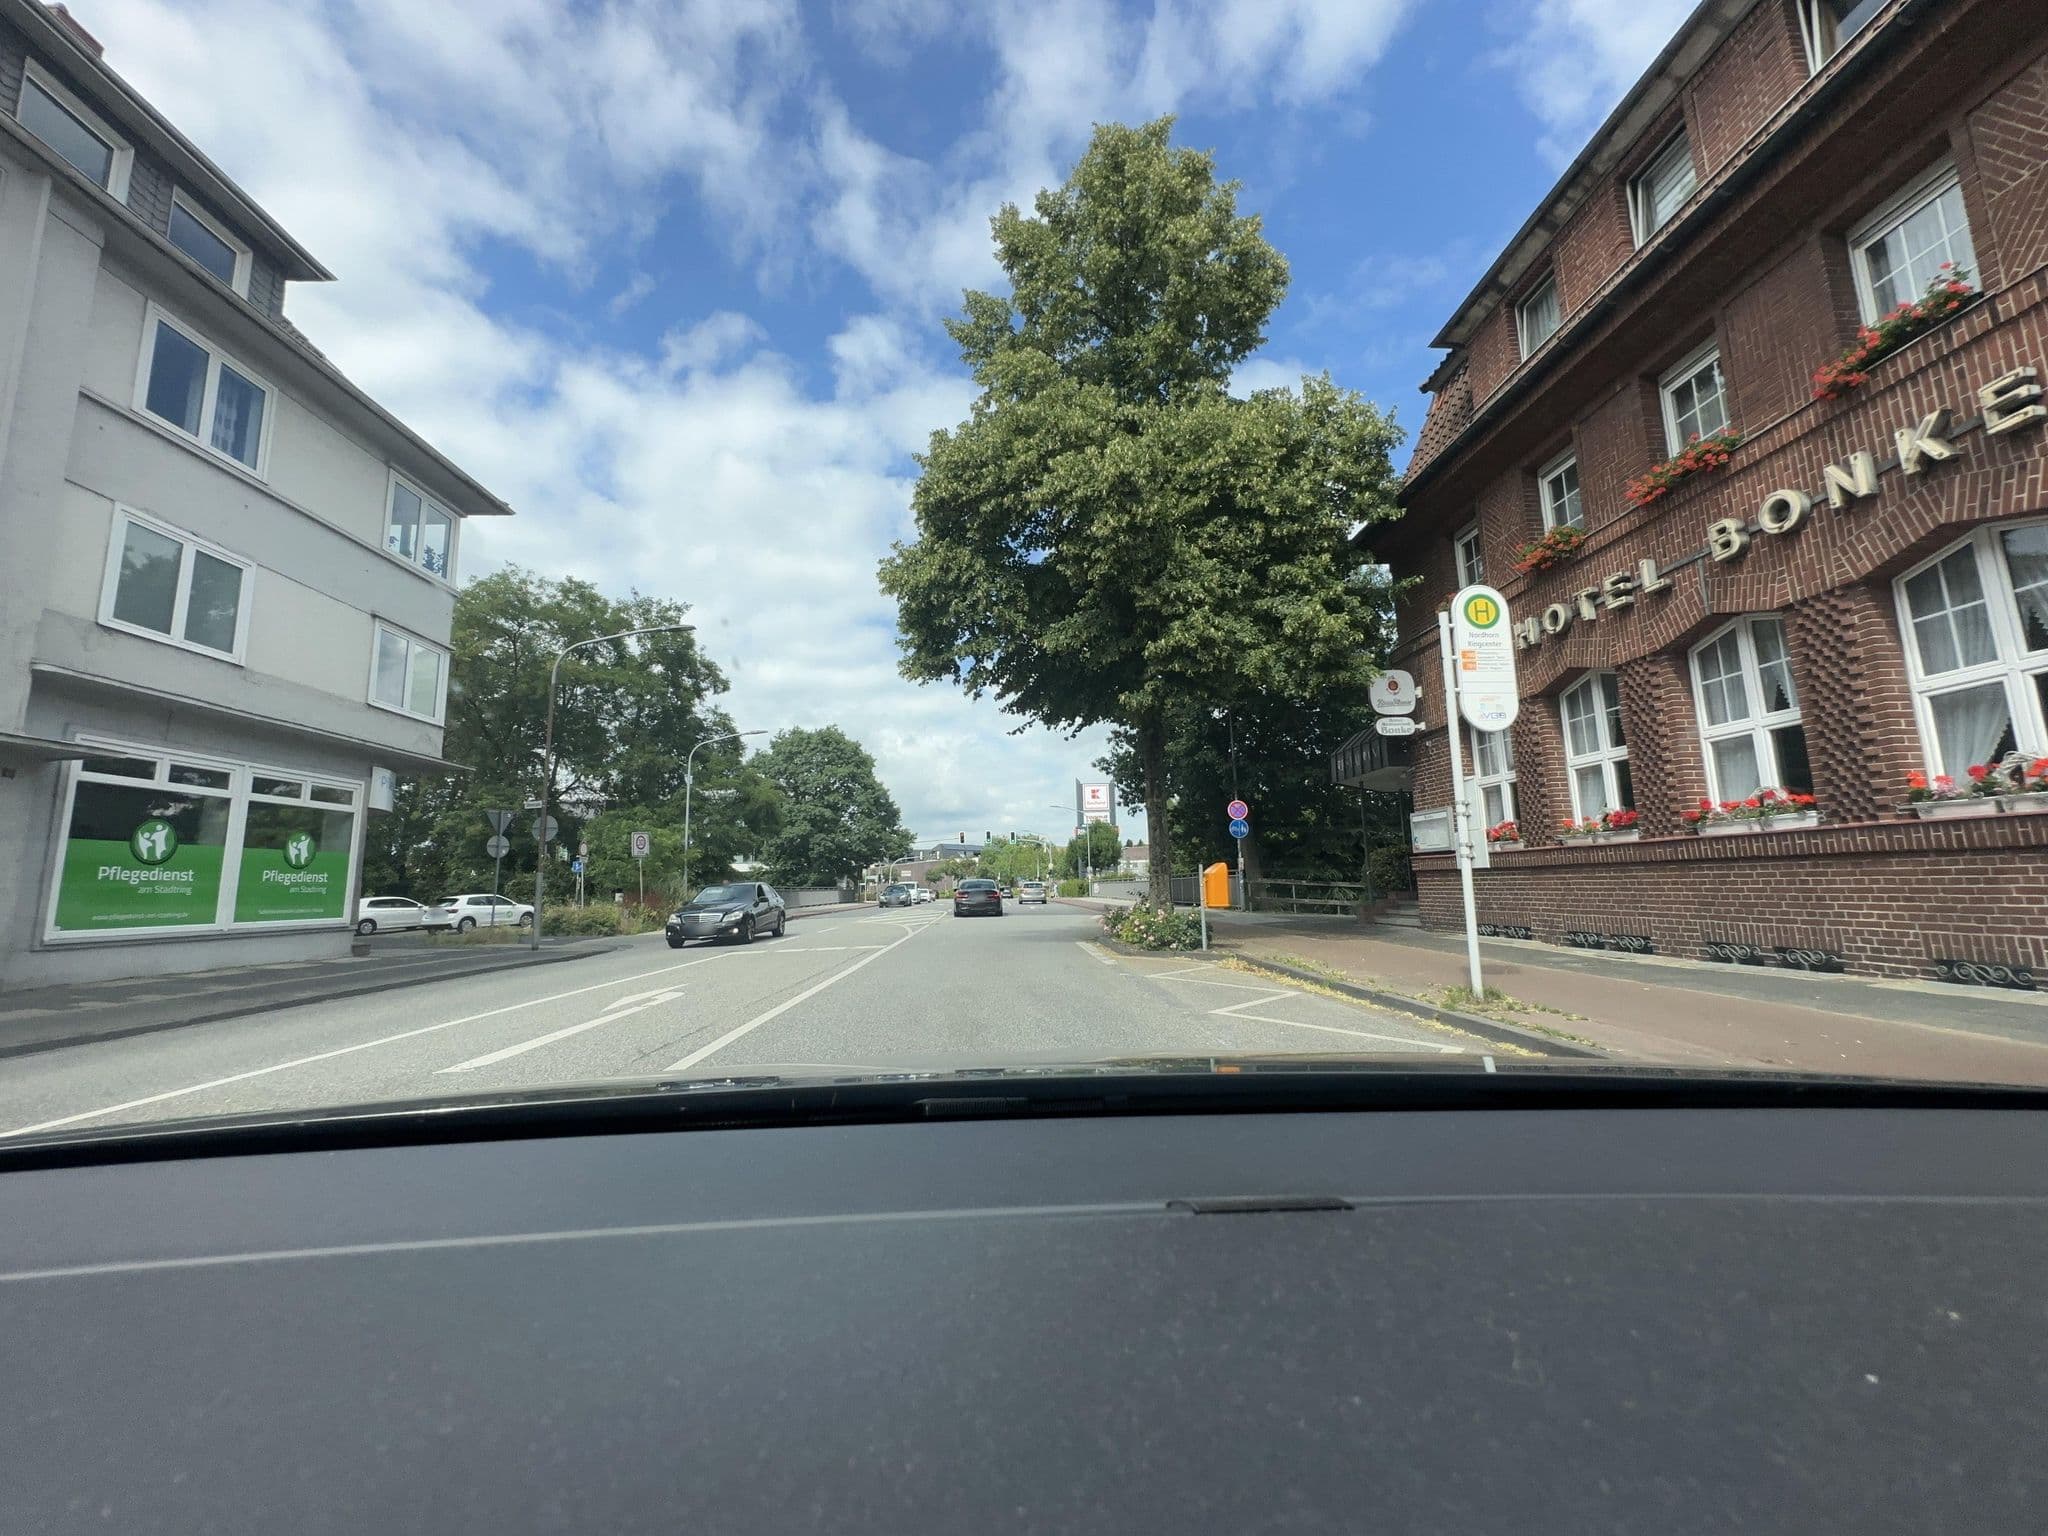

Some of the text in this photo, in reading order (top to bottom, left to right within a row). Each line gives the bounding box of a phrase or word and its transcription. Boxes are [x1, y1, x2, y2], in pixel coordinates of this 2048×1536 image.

[1513, 365, 2048, 650] HOTEL BONKE
[1474, 602, 1490, 621] H
[97, 866, 195, 884] Pflegedienst
[262, 870, 329, 886] Pflegedienst
[154, 885, 193, 896] Stadtring
